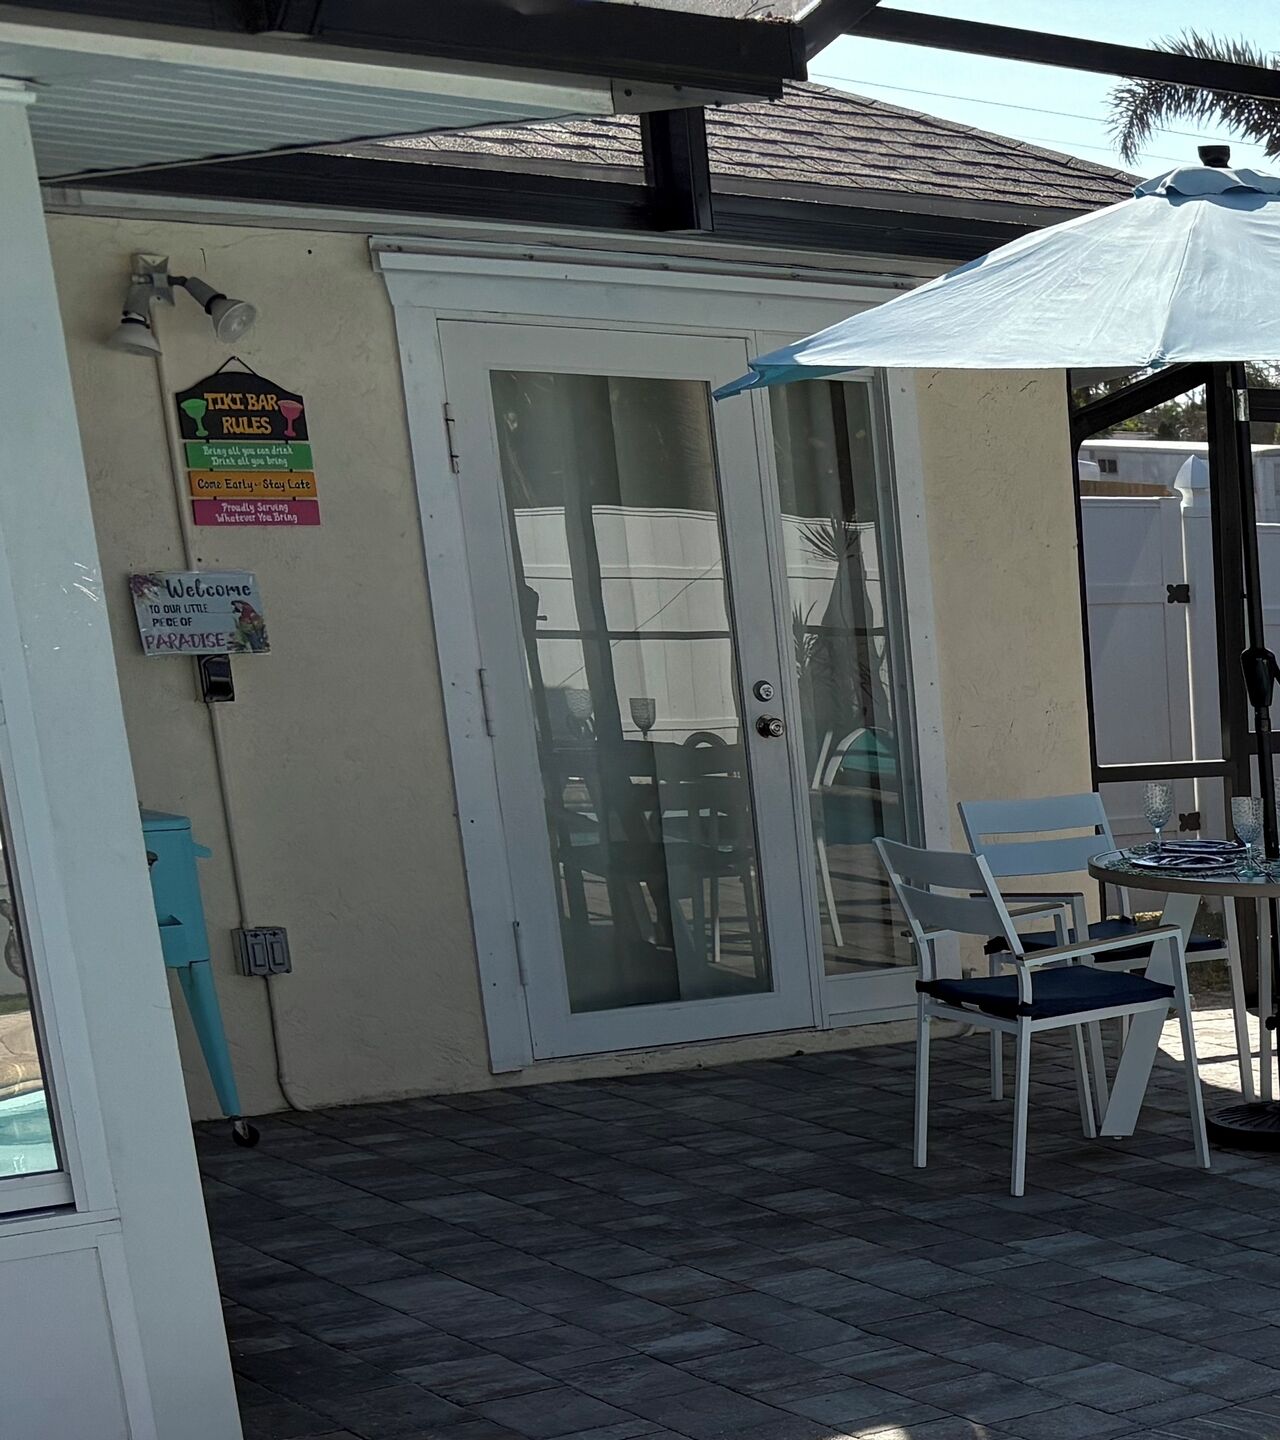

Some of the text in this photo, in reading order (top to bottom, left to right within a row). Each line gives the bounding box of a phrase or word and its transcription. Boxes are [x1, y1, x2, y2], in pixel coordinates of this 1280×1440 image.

[204, 392, 279, 411] TIKI BAR
[221, 416, 272, 435] RULES
[202, 445, 227, 457] Bring
[227, 446, 240, 455] all
[241, 447, 255, 457] you
[211, 456, 236, 466] Drink
[237, 456, 250, 465] all
[250, 458, 265, 467] you
[197, 478, 222, 489] Come
[263, 478, 285, 492] Stay
[287, 478, 311, 489] Late
[221, 502, 289, 513] Proudly Serving
[215, 512, 298, 524] Whatever You Bring
[165, 578, 252, 599] Welcome
[149, 604, 160, 614] TO
[163, 604, 181, 614] OUR
[180, 617, 193, 627] OF
[144, 632, 226, 651] PARADISE
